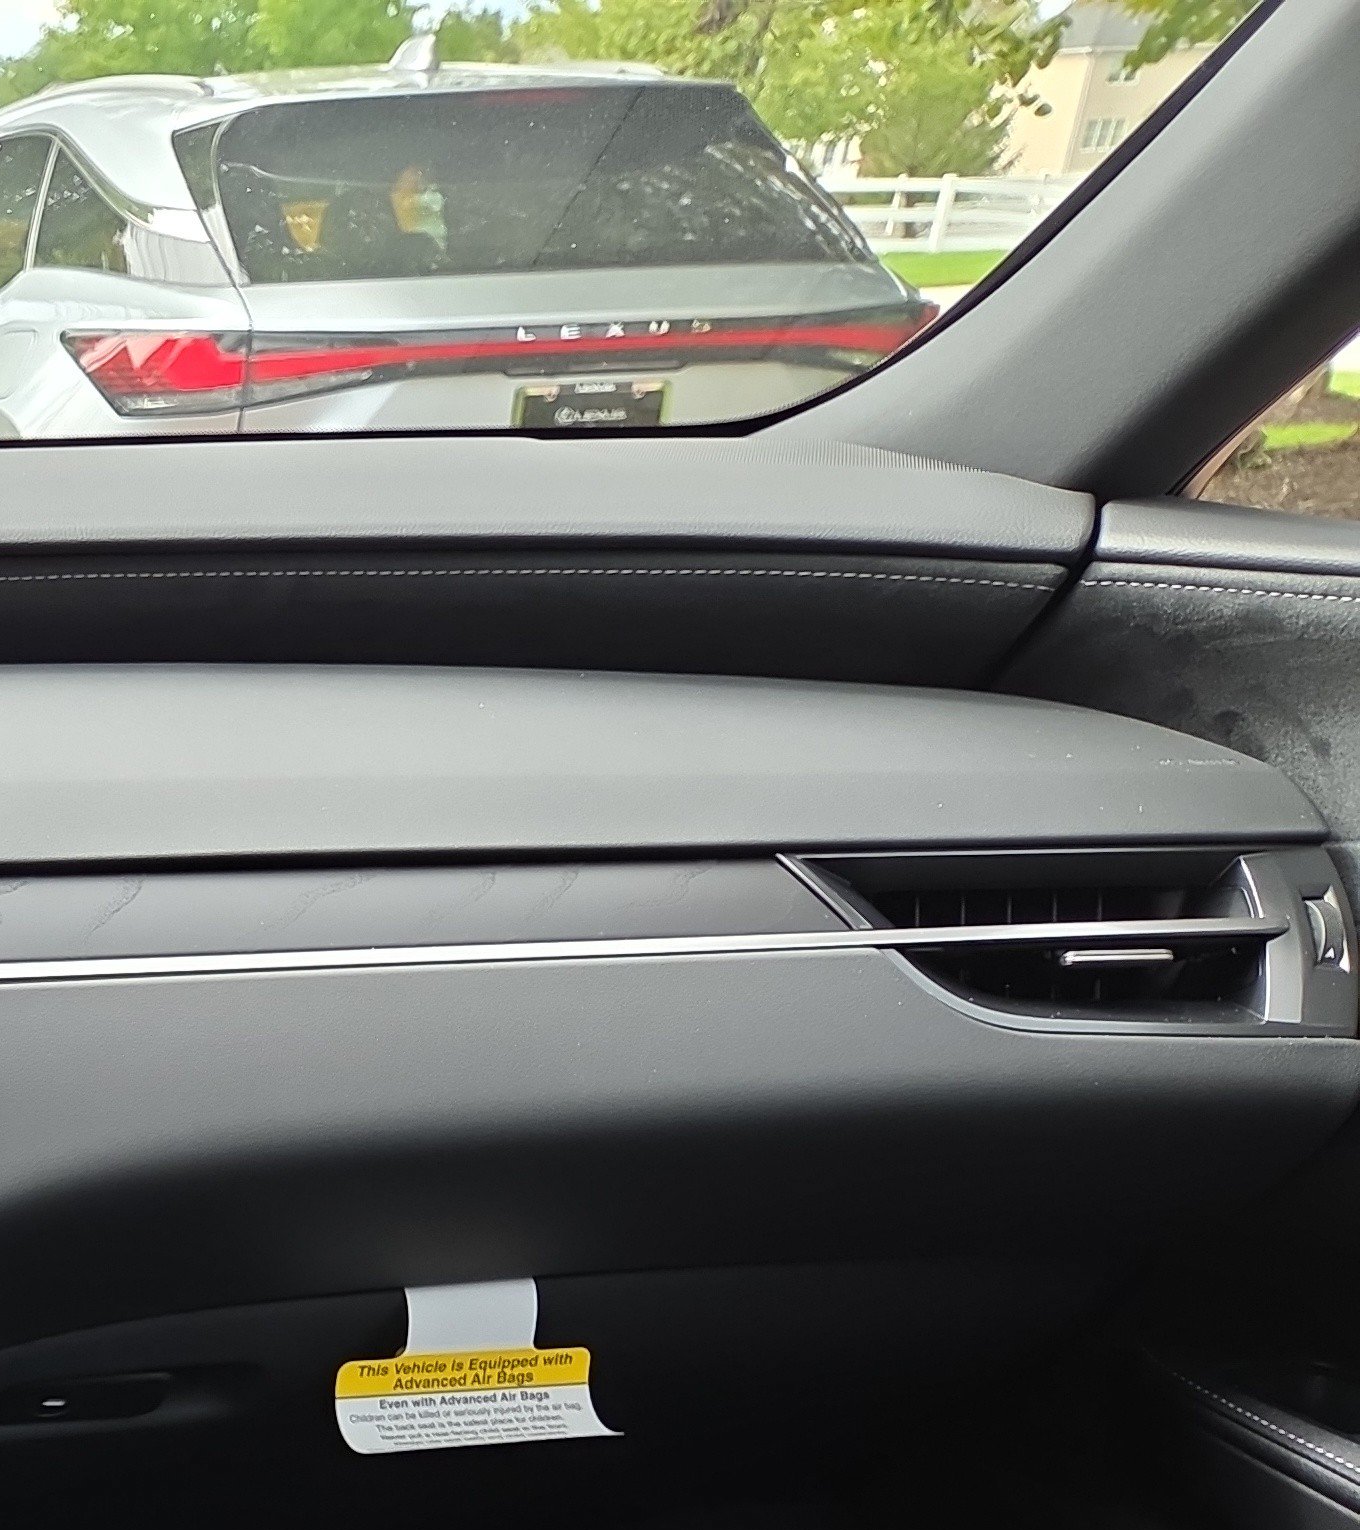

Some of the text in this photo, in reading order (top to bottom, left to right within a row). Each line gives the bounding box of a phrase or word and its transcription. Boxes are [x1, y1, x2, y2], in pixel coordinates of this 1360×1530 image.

[517, 319, 712, 341] LEXUS
[357, 1351, 573, 1377] This Vehicle is Equipped with
[392, 1367, 534, 1391] Advanced Air Bags
[379, 1389, 549, 1409] Even with Advanced Air Bags
